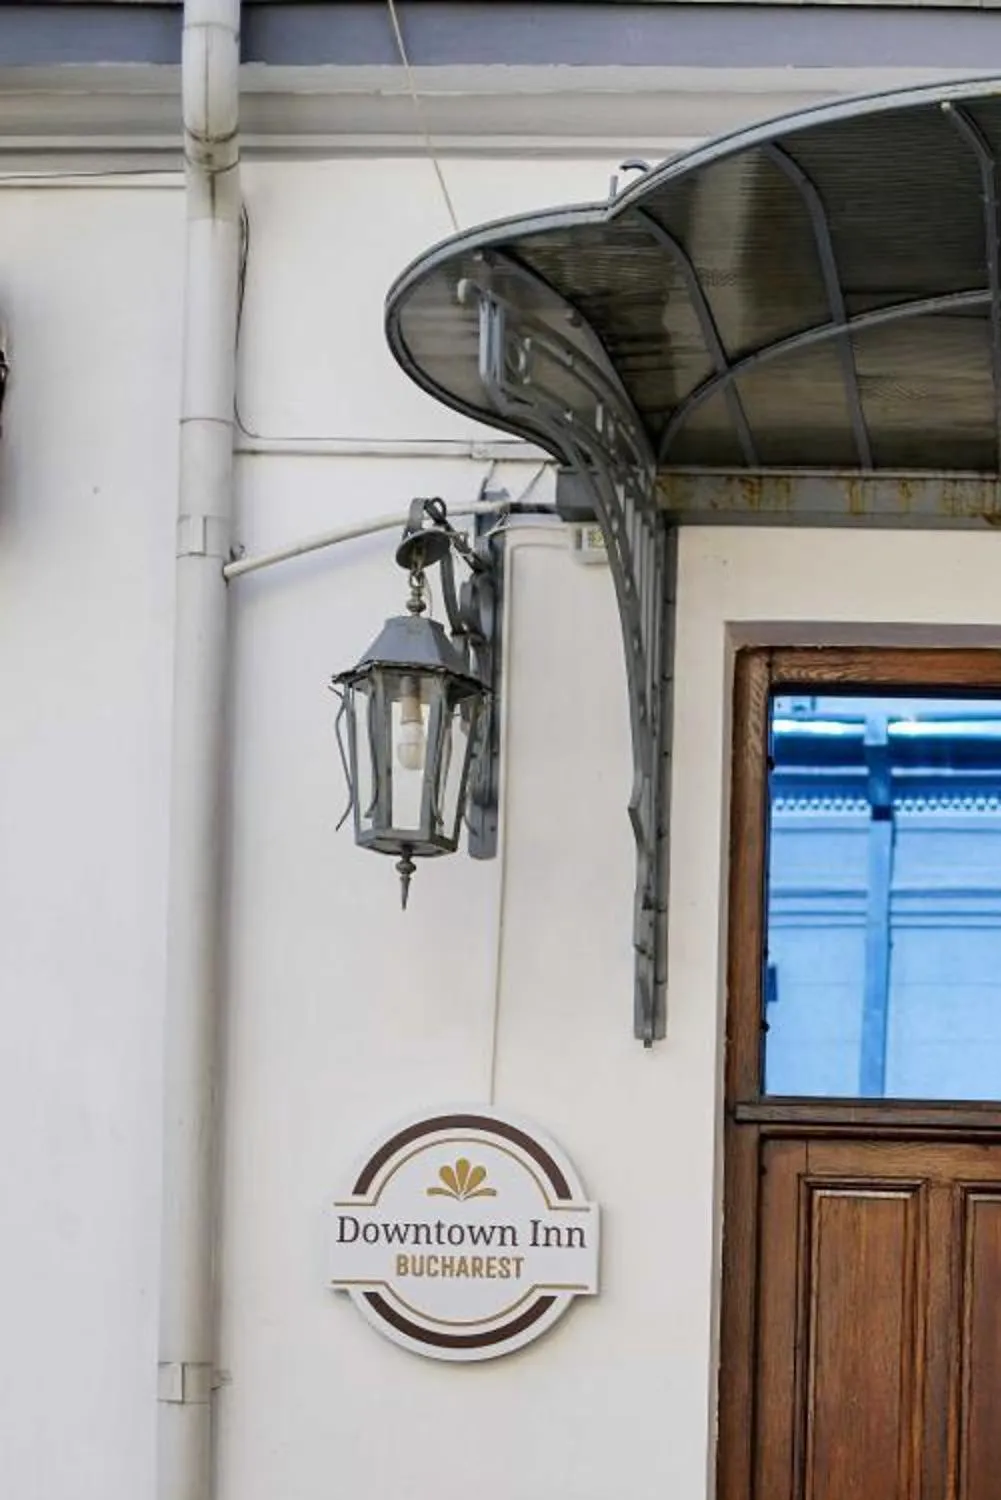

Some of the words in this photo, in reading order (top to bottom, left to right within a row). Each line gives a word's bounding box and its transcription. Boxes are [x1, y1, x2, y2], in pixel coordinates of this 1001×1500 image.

[336, 1215, 519, 1247] Downtown
[529, 1219, 587, 1248] Inn
[395, 1254, 525, 1279] BUCHAREST
